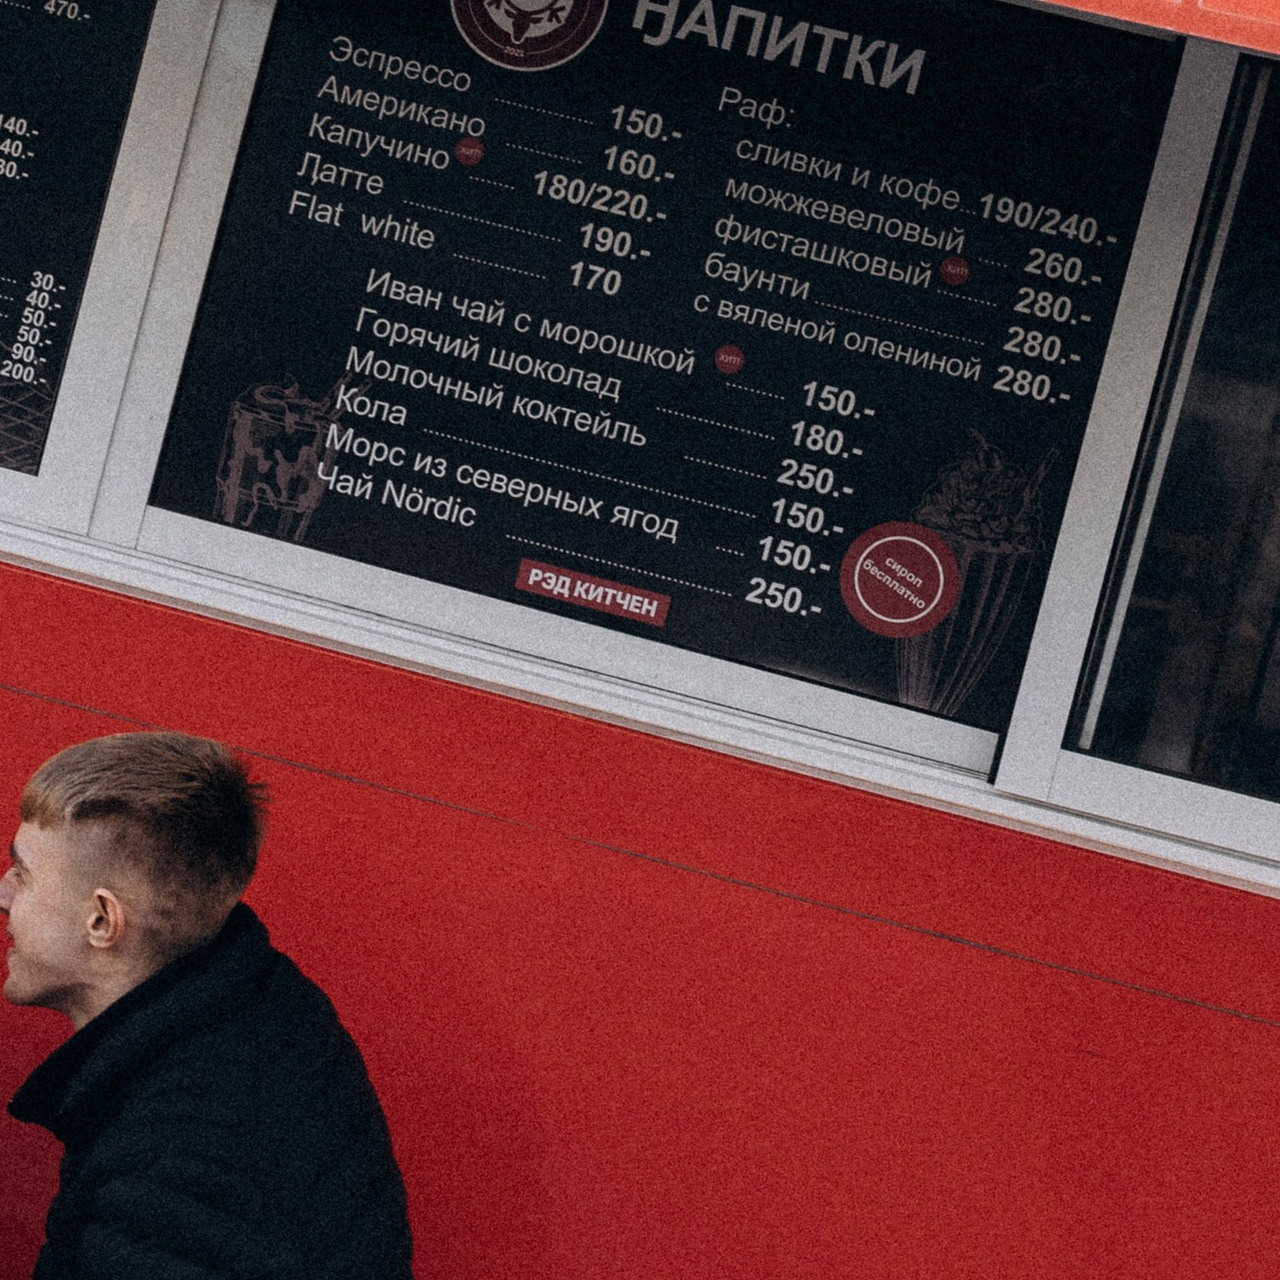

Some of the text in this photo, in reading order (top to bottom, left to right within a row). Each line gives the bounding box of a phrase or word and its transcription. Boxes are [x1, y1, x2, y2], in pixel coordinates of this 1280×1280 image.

[316, 75, 675, 182] Американо 160.-
[329, 35, 682, 141] Эспрессо 150.-
[718, 86, 795, 130] Раф:
[308, 112, 666, 222] Капучино 180/220.-
[735, 139, 1117, 246] сливки и кофе 190/240.-
[30, 270, 66, 292] 30.-
[288, 189, 622, 295] Flat white 170
[580, 222, 651, 260] 190.-
[714, 213, 1091, 325] фисташковый 280.-
[725, 178, 1101, 286] можжевеловый 260.-
[16, 325, 52, 347] 50.-
[21, 306, 56, 328] 50.-
[25, 289, 61, 310] 40.-
[366, 267, 875, 419] Иван чай с морошкой 150.-
[693, 294, 1070, 404] с вяленой олениной 280.-
[704, 251, 1080, 364] баунти 280.-
[0, 359, 46, 385] 200.-
[11, 342, 46, 365] 90.-
[355, 306, 863, 458] Горячий шоколад 180.-
[335, 383, 844, 536] Кола 150.-
[345, 345, 853, 497] Молочный коктейль 250.-
[316, 461, 821, 616] Чай Nördic 250.-
[325, 423, 830, 574] Морс из северных ягод 150.-
[528, 568, 658, 617] РЭД КИТЧЕН
[862, 559, 926, 609] бесплатно
[885, 557, 923, 587] сироп
